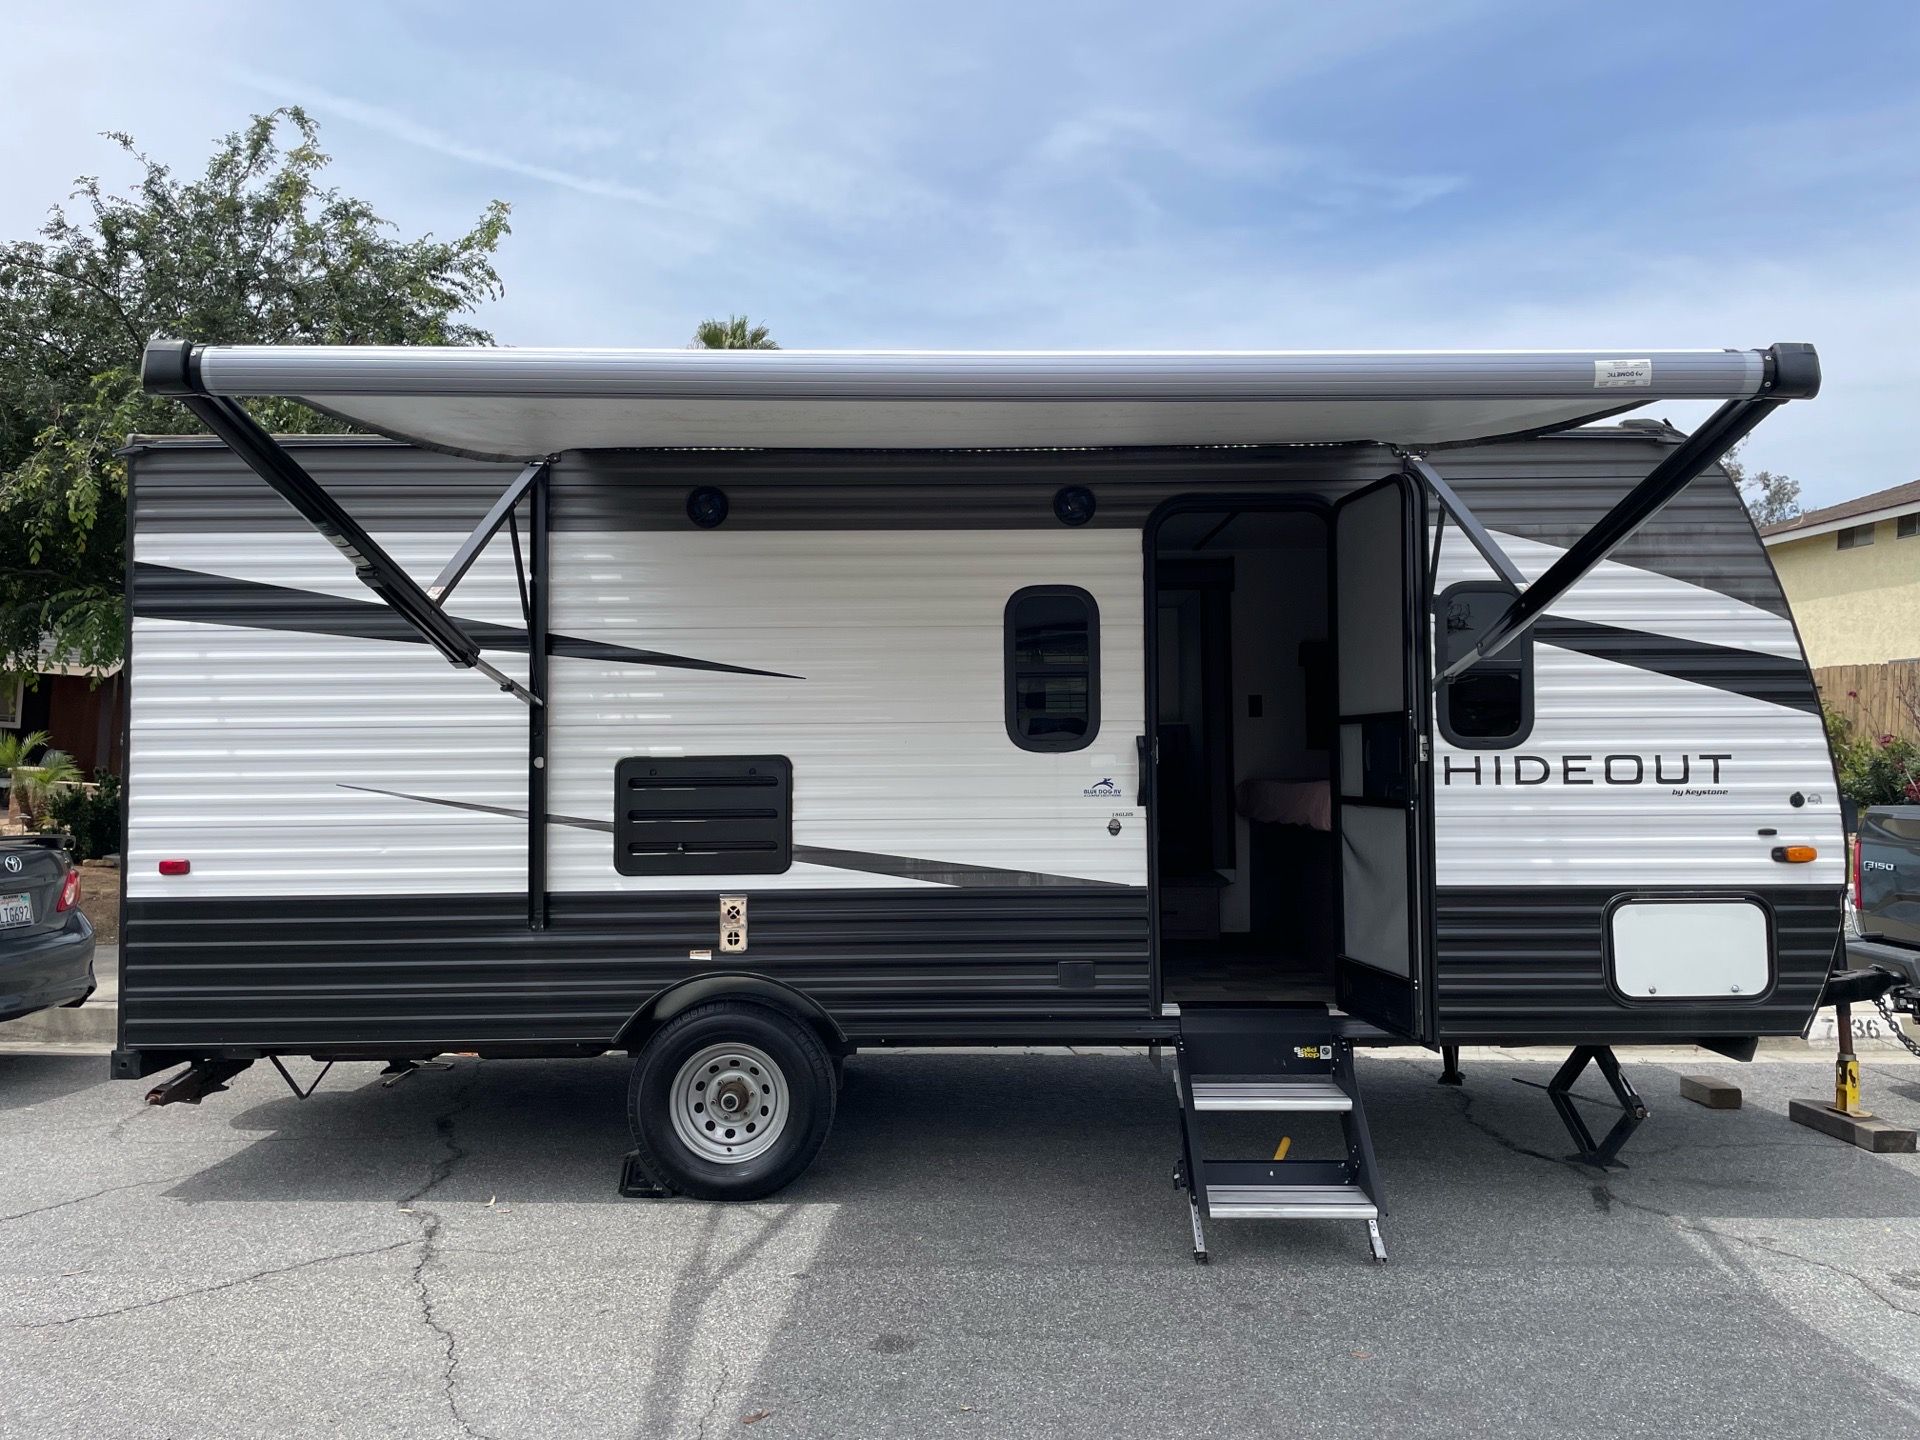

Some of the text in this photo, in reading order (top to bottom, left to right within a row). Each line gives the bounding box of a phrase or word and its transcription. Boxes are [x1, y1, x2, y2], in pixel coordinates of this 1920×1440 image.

[1443, 754, 1732, 786] HIDEOUT
[1671, 788, 1729, 797] by Keystone
[1863, 860, 1894, 871] F150
[1820, 1018, 1881, 1039] 736
